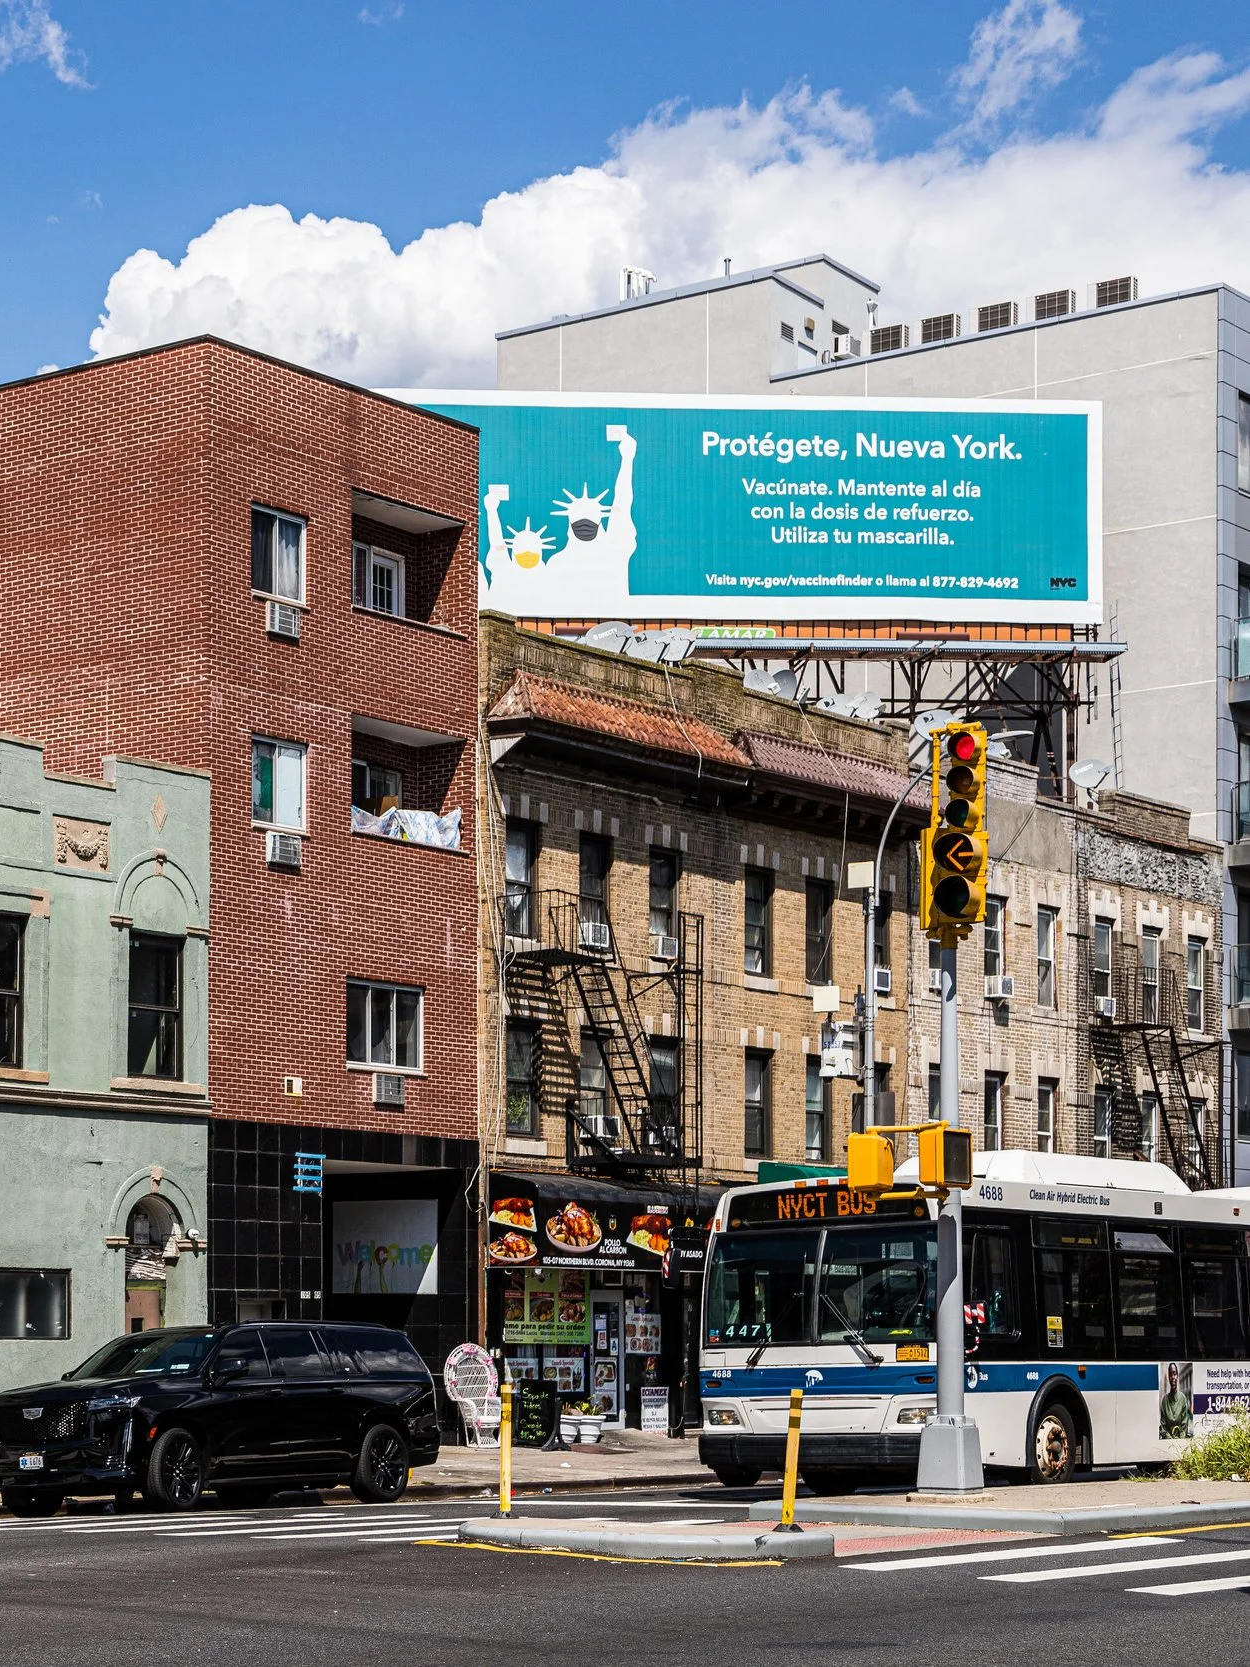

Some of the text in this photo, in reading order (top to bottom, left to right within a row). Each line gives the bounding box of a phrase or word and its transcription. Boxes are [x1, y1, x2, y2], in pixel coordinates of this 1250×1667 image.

[702, 431, 1022, 463] Protégete, Nueva York.
[741, 478, 981, 498] Vacúnate. Mantente al día
[751, 502, 974, 522] con la dosis de refuerzo.
[771, 526, 954, 546] Utiliza tu mascarilla.
[705, 574, 1019, 589] Visita nyc.gov/vaccinefinder o llama al 877-829-4692
[1050, 577, 1077, 588] NYC
[979, 1185, 1003, 1201] 4688
[1030, 1189, 1110, 1206] Clean Air Hybrid Electric Bus
[777, 1191, 877, 1219] NYCT BUS
[604, 1238, 621, 1247] POLLO
[599, 1246, 627, 1254] AL CARBON
[686, 1250, 703, 1258] ASADO
[558, 1257, 583, 1265] NORTHERN
[616, 1259, 623, 1267] NY
[538, 1323, 555, 1331] pedir
[712, 1370, 732, 1379] 4688
[1027, 1372, 1038, 1380] 4688
[1206, 1369, 1219, 1378] Need
[1221, 1369, 1231, 1379] help
[1233, 1369, 1244, 1378] with
[1206, 1381, 1250, 1391] transportation, or
